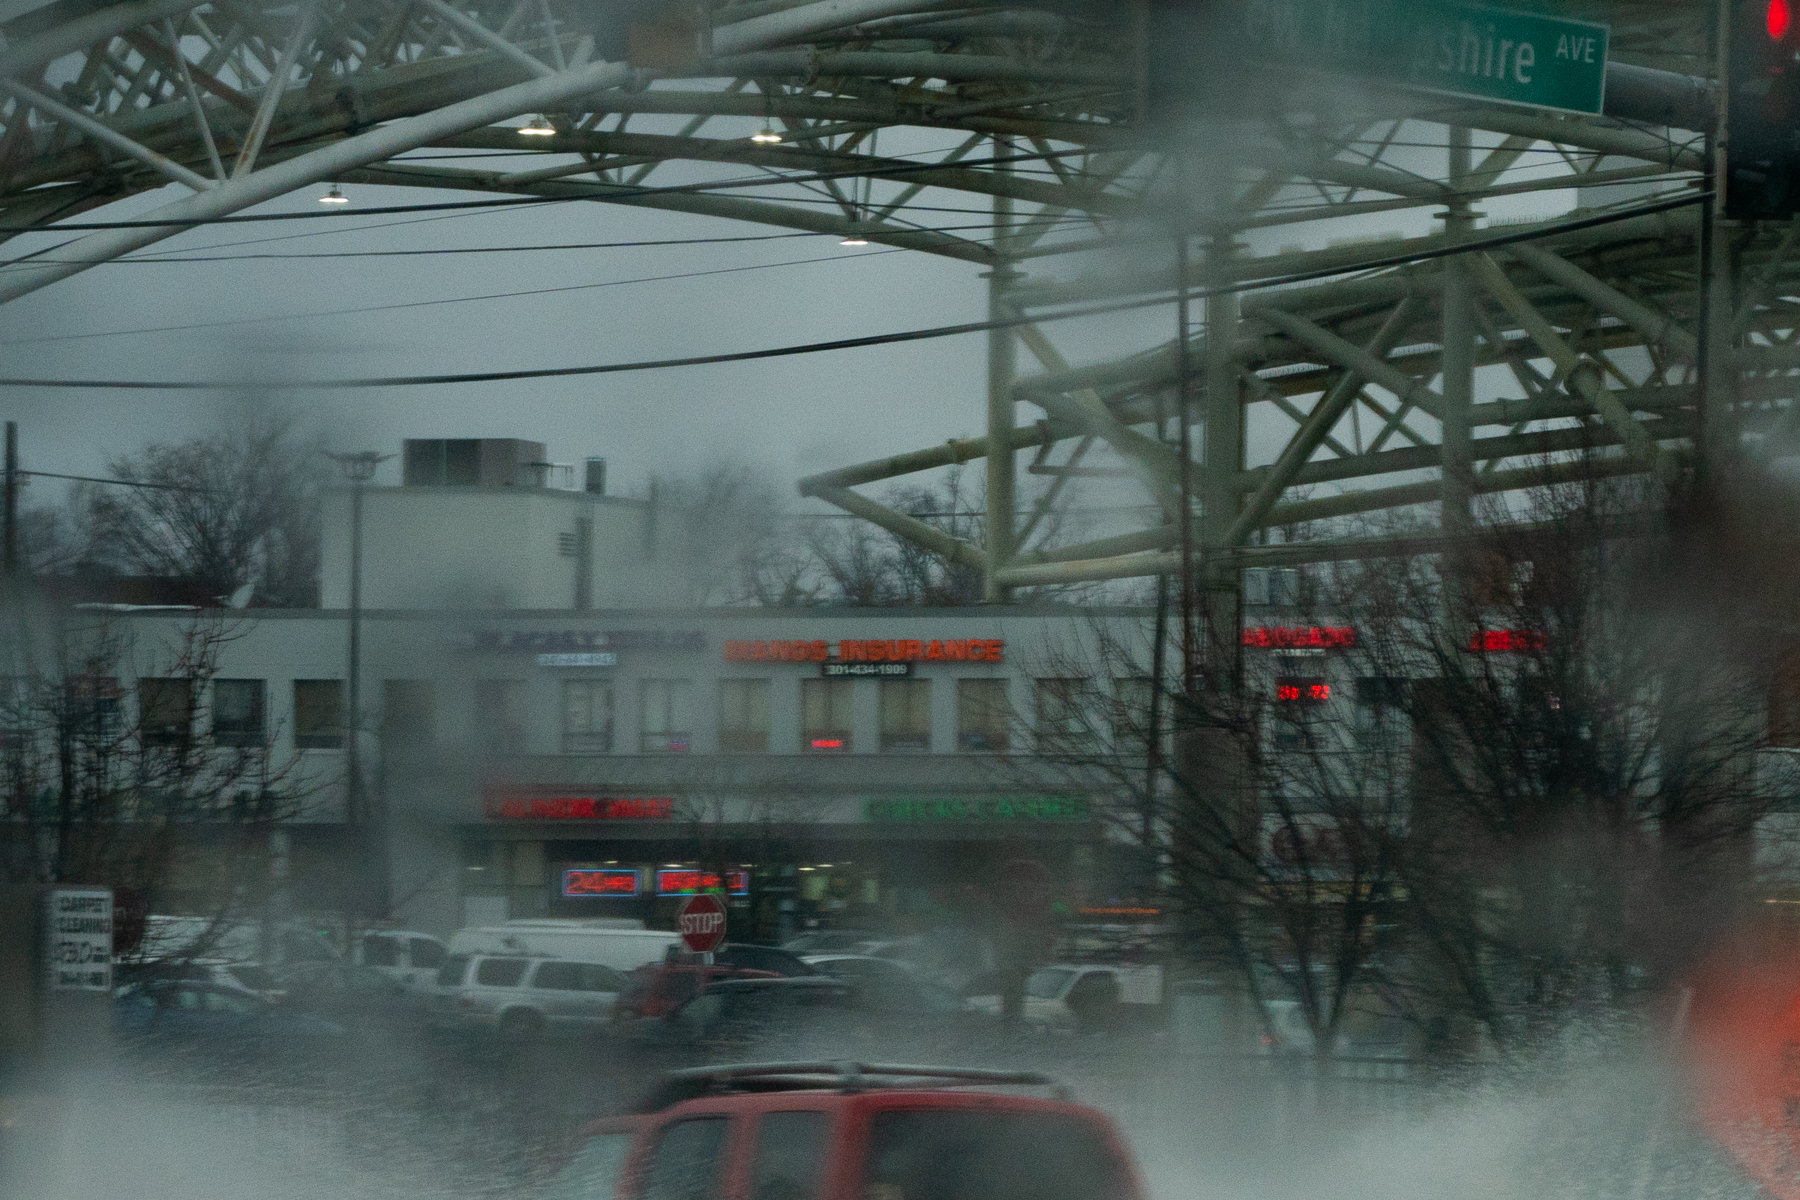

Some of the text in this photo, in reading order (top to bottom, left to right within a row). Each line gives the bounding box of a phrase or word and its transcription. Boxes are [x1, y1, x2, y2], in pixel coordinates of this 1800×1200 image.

[1554, 33, 1597, 64] AVE
[839, 639, 1005, 662] INSURANCE
[682, 912, 724, 934] STOP
